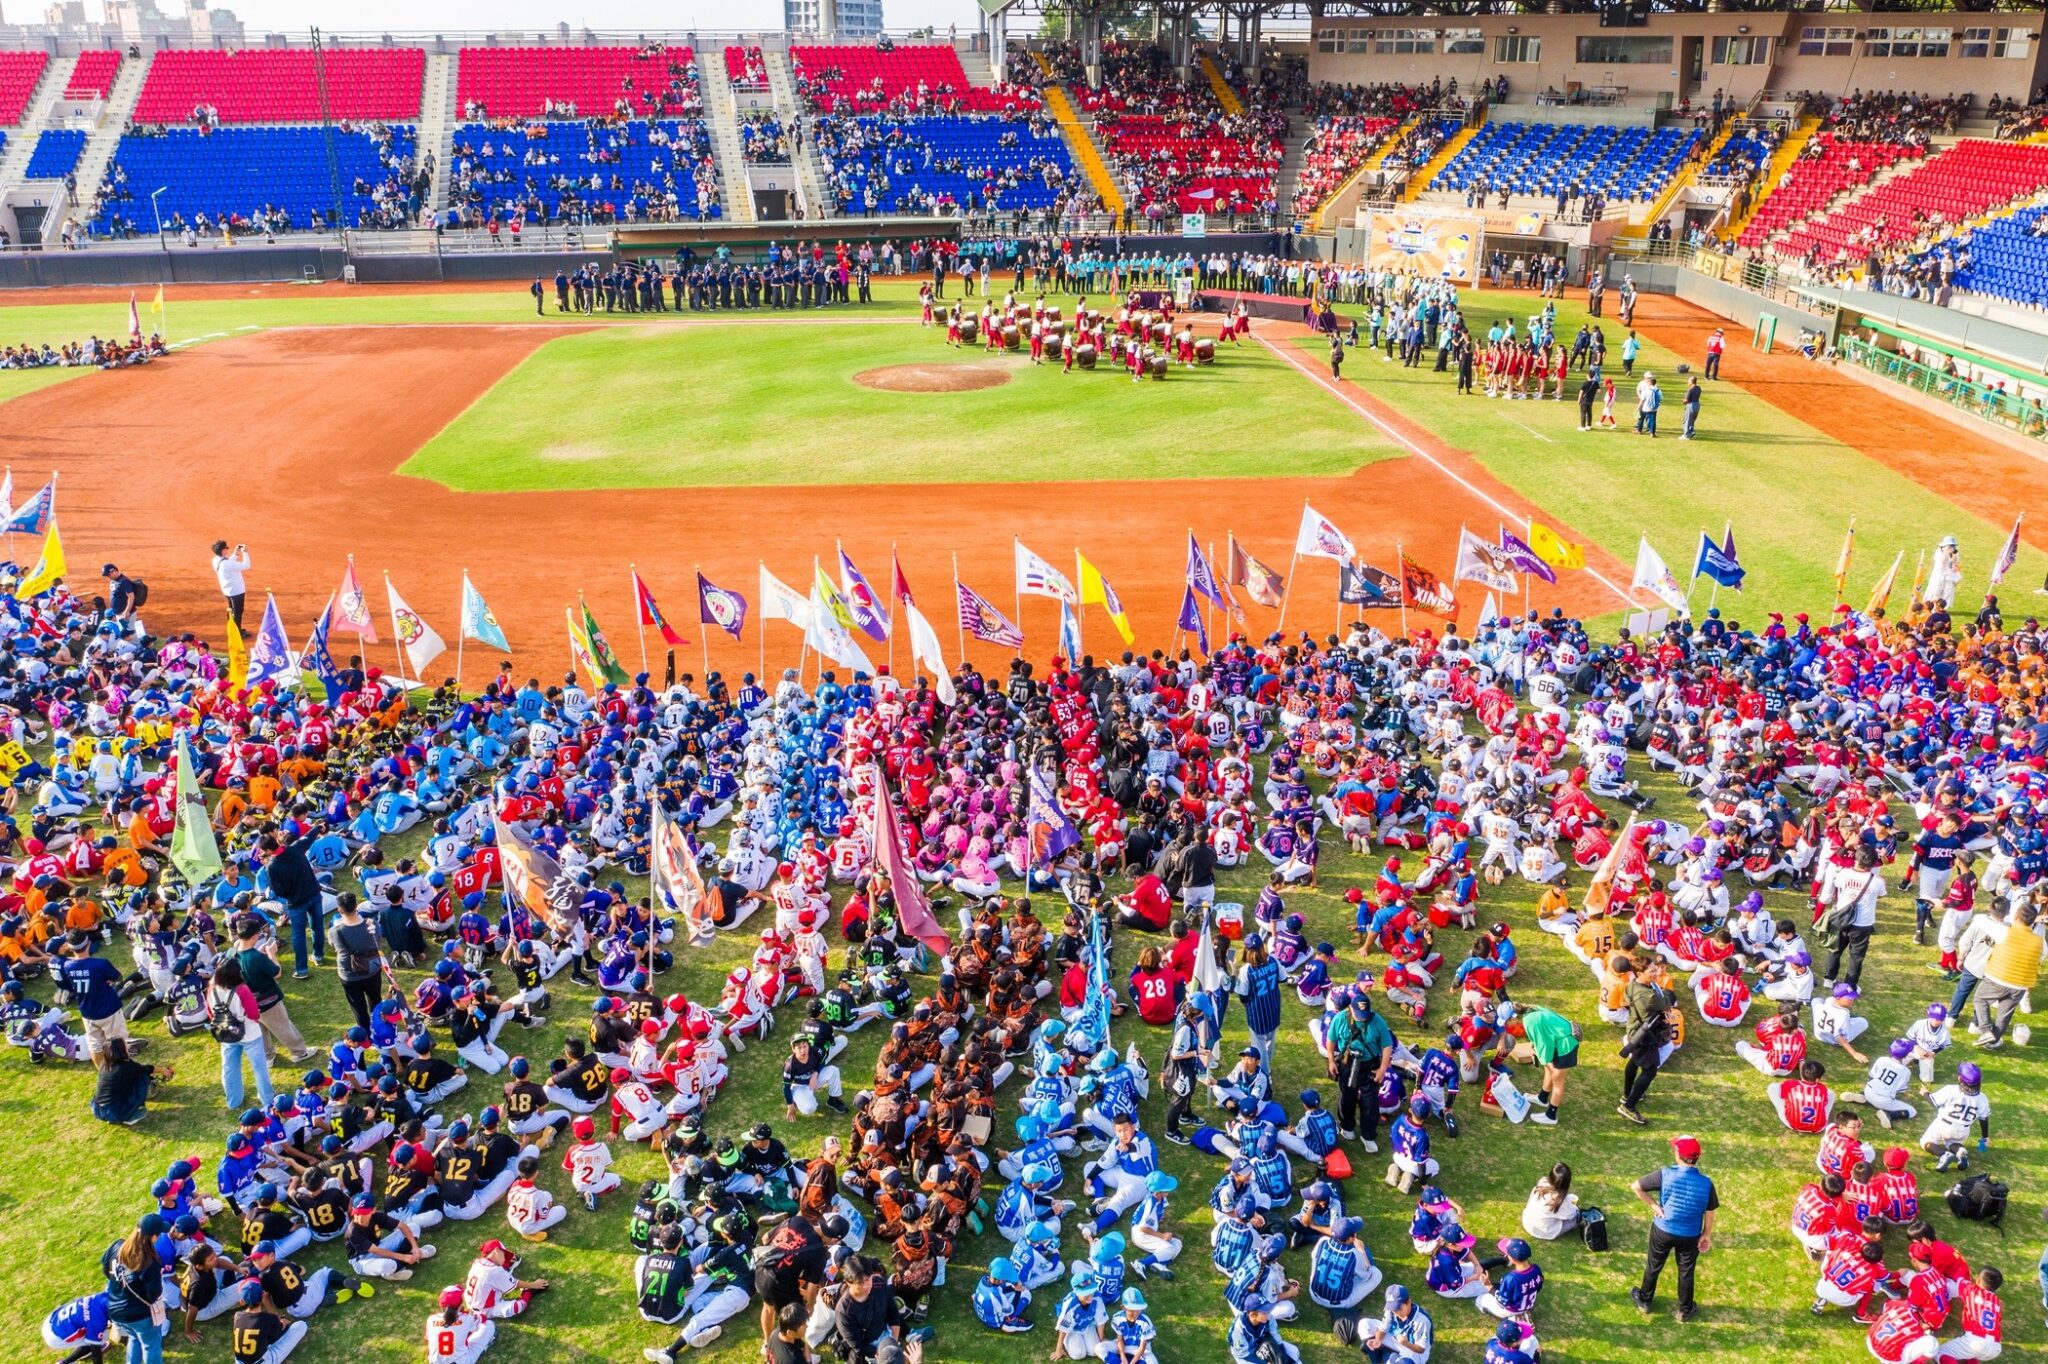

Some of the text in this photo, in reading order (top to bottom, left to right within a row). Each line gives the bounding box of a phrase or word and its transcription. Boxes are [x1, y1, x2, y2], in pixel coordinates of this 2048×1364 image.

[88, 612, 98, 625] 31
[1561, 653, 1574, 664] 58
[1185, 668, 1192, 679] 7
[1537, 680, 1554, 692] 66
[565, 694, 579, 705] 10
[740, 691, 753, 702] 10
[1012, 688, 1028, 702] 20
[1192, 694, 1200, 706] 9
[520, 699, 534, 710] 10
[1765, 698, 1781, 711] 22
[1058, 708, 1072, 720] 53
[1388, 711, 1402, 722] 11
[1212, 722, 1226, 735] 12
[12, 752, 26, 764] 5
[476, 745, 484, 758] 3
[564, 750, 570, 761] 6
[482, 803, 489, 816] 4
[324, 847, 334, 860] 8
[446, 843, 454, 856] 9
[1221, 841, 1230, 854] 3
[843, 852, 852, 866] 6
[457, 873, 474, 887] 18
[779, 898, 793, 909] 16
[1595, 936, 1612, 952] 15
[527, 971, 536, 986] 3
[1252, 963, 1276, 979] TAIPEI
[73, 979, 90, 994] 77
[1144, 981, 1167, 998] 28
[1256, 976, 1277, 996] 27
[1720, 991, 1731, 1008] 3
[630, 1002, 652, 1018] 35
[826, 1005, 841, 1020] 98
[582, 1063, 606, 1090] 26
[1426, 1070, 1443, 1086] 15
[1879, 1069, 1897, 1085] 18
[691, 1078, 700, 1093] 6
[634, 1088, 648, 1102] 8
[510, 1094, 531, 1113] 18
[1803, 1107, 1815, 1122] 2
[1949, 1104, 1978, 1121] 26
[1324, 1128, 1336, 1143] 6
[446, 1160, 470, 1180] 12
[582, 1167, 592, 1182] 2
[1270, 1175, 1283, 1192] 5
[309, 1204, 334, 1226] 18
[1857, 1203, 1868, 1220] 8
[1892, 1200, 1917, 1218] 13
[280, 1266, 299, 1289] 8
[1318, 1265, 1343, 1289] 15
[1828, 1262, 1856, 1287] 16
[648, 1271, 668, 1296] 21
[1096, 1276, 1118, 1294] 72
[1981, 1310, 1994, 1329] 6
[234, 1329, 259, 1355] 15
[438, 1332, 454, 1355] 8
